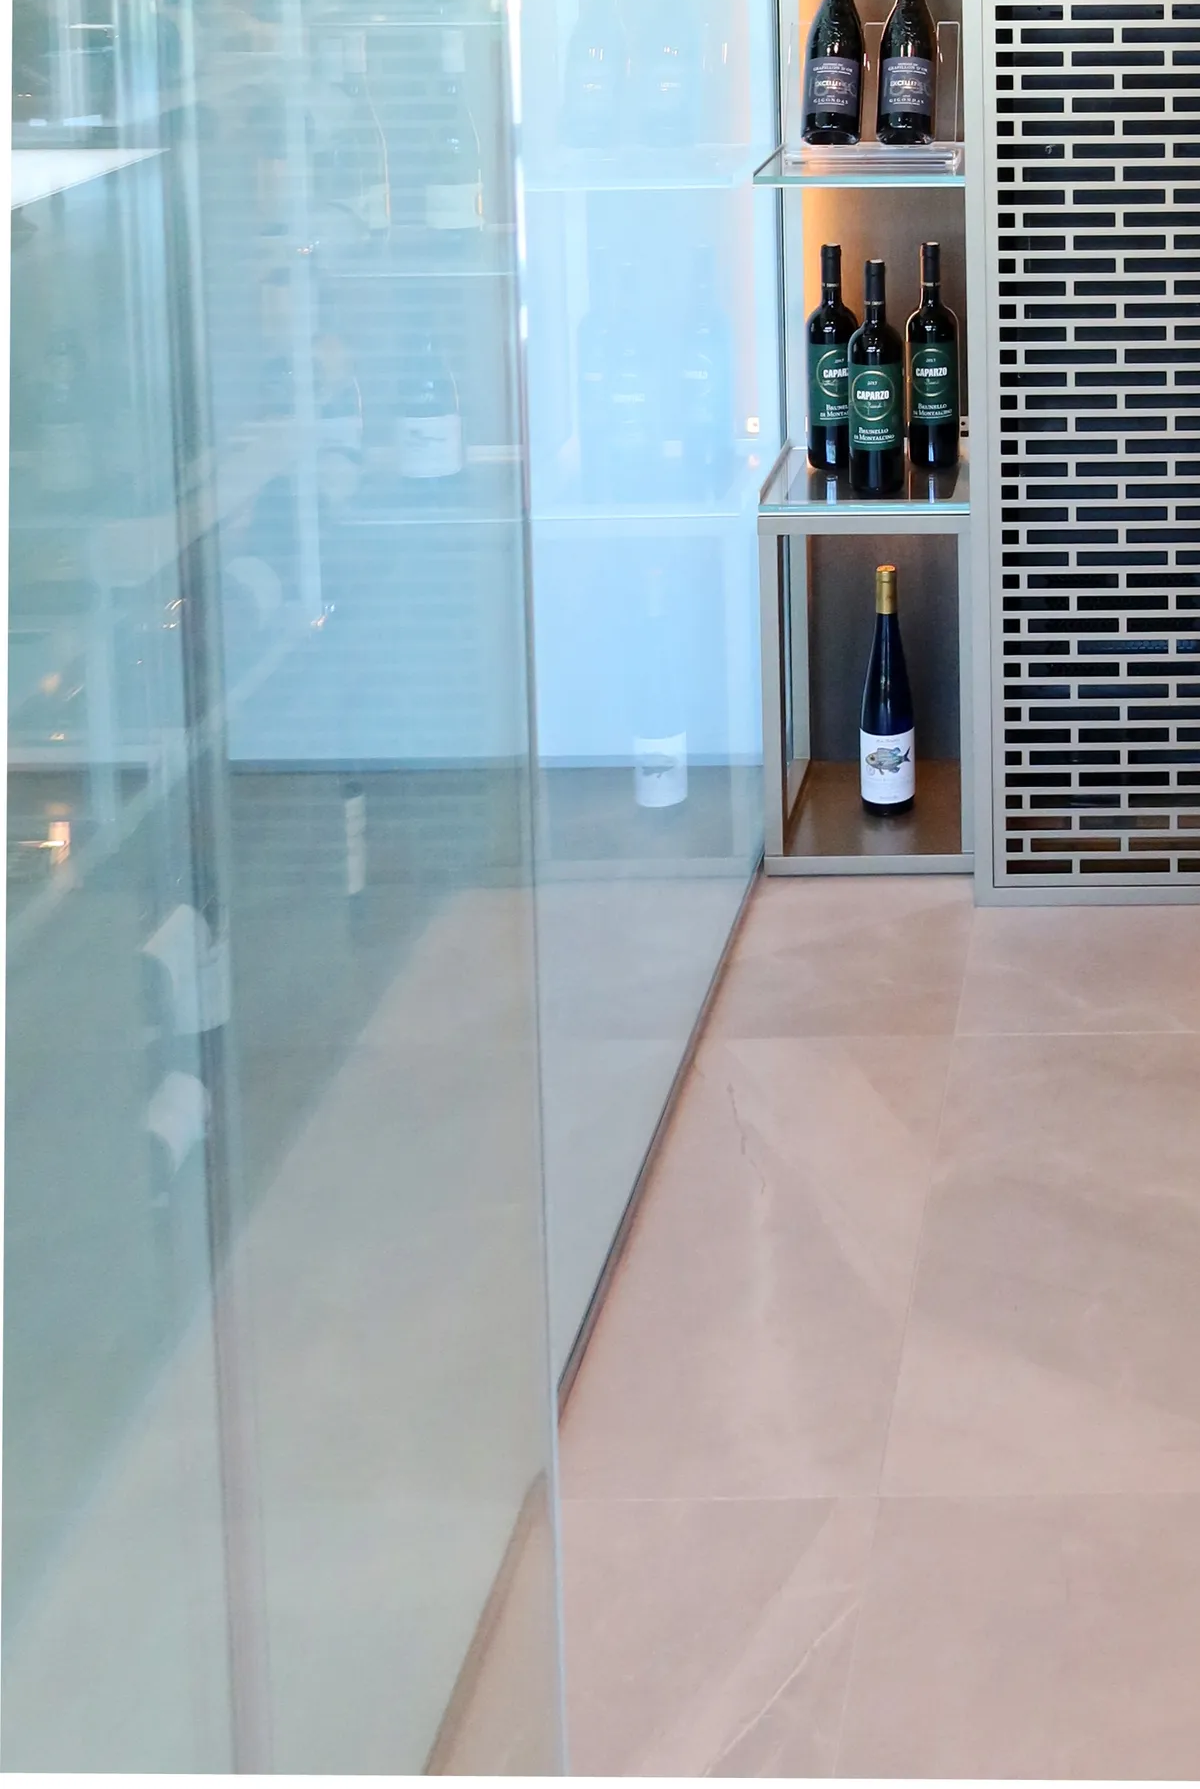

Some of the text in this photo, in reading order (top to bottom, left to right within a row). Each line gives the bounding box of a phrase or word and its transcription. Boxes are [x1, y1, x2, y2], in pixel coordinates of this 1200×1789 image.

[823, 368, 850, 378] CAPAR
[915, 367, 948, 377] CAPARZO
[856, 390, 890, 400] CAPARZO
